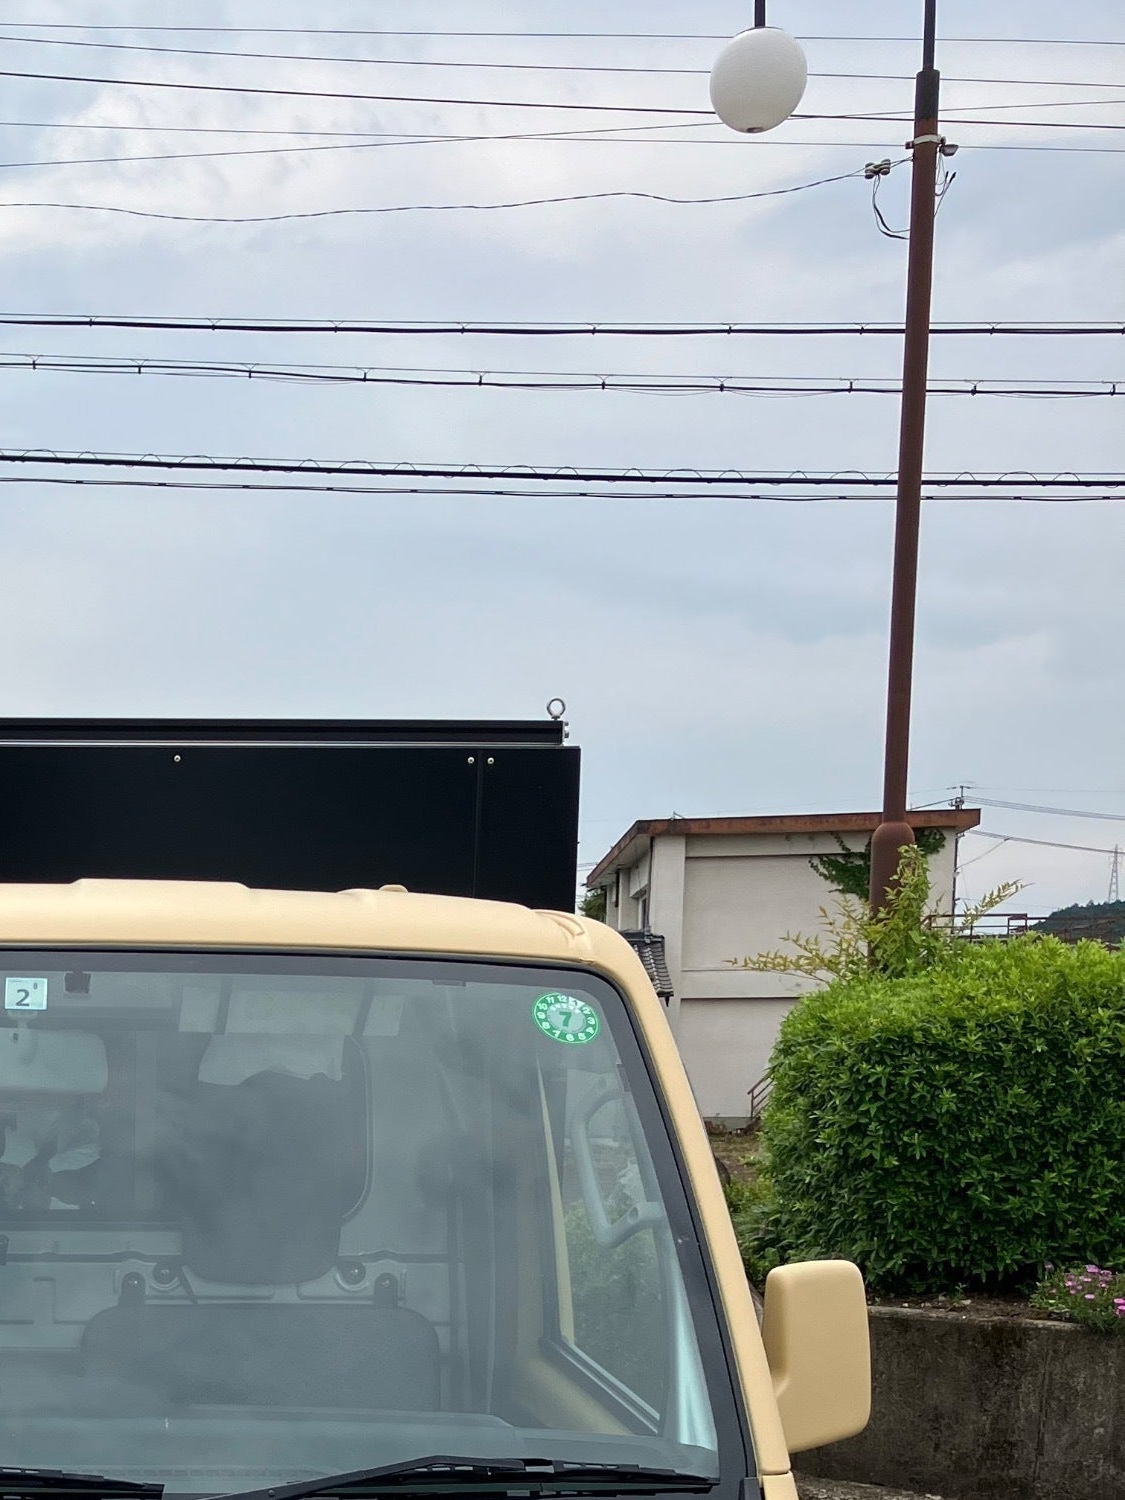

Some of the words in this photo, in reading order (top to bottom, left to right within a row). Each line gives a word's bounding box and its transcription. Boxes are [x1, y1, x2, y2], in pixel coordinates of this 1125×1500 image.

[15, 989, 30, 1007] 2
[557, 995, 567, 1003] 12
[559, 1011, 572, 1027] 7
